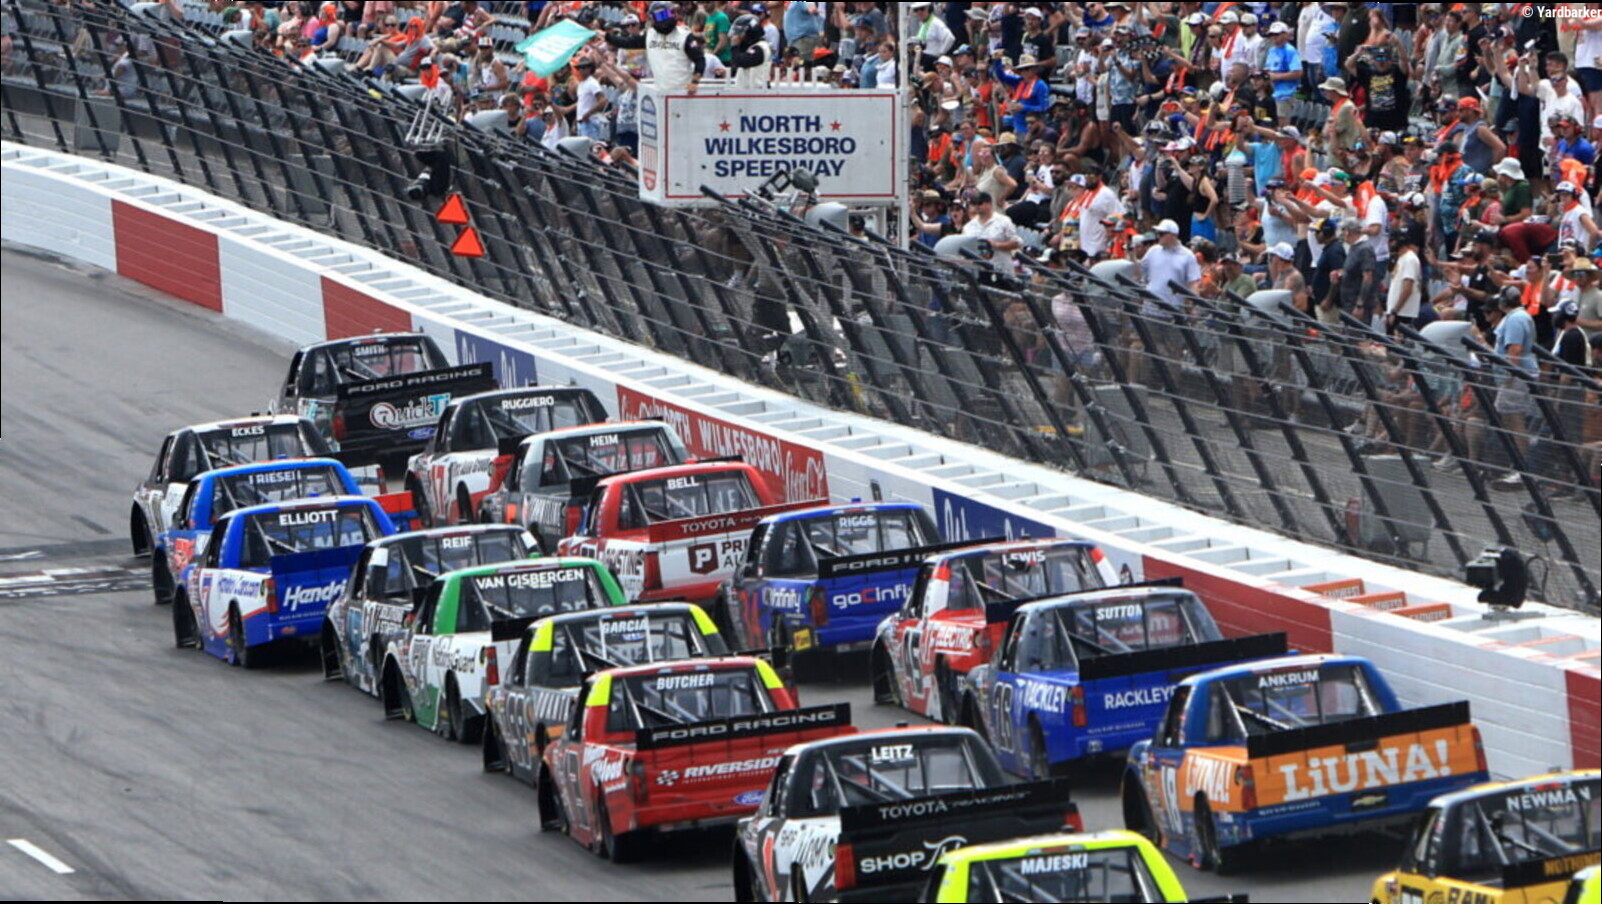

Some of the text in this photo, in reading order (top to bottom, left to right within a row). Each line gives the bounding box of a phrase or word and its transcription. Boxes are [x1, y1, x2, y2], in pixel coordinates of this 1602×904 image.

[740, 115, 820, 133] NORTH
[704, 137, 856, 155] WILKESBORO
[714, 159, 846, 177] SPEEDWAY
[354, 344, 386, 356] SMITH
[347, 379, 402, 394] FORD
[406, 368, 483, 388] RACING
[501, 396, 555, 411] RUGGIERO
[231, 425, 266, 438] ECKES
[589, 434, 619, 447] HEIM
[666, 476, 700, 490] BELL
[278, 510, 339, 526] ELLIOTT
[681, 517, 736, 533] TOYOTA
[442, 536, 472, 550] REIF
[832, 556, 899, 572] FORD
[475, 568, 585, 591] VAN GISBERGEN
[1096, 604, 1143, 620] SUTTON
[601, 618, 649, 635] GARCIA
[656, 673, 715, 690] BUTCHER
[1258, 669, 1320, 688] ANKRUM
[651, 710, 836, 742] FORD RACING
[871, 744, 914, 763] LEITZ
[1279, 738, 1452, 803] LiUNA!
[1505, 786, 1592, 812] NEWMAN
[878, 800, 948, 820] TOYOTA
[860, 852, 926, 873] SHOP
[1020, 853, 1089, 875] MAJESKI
